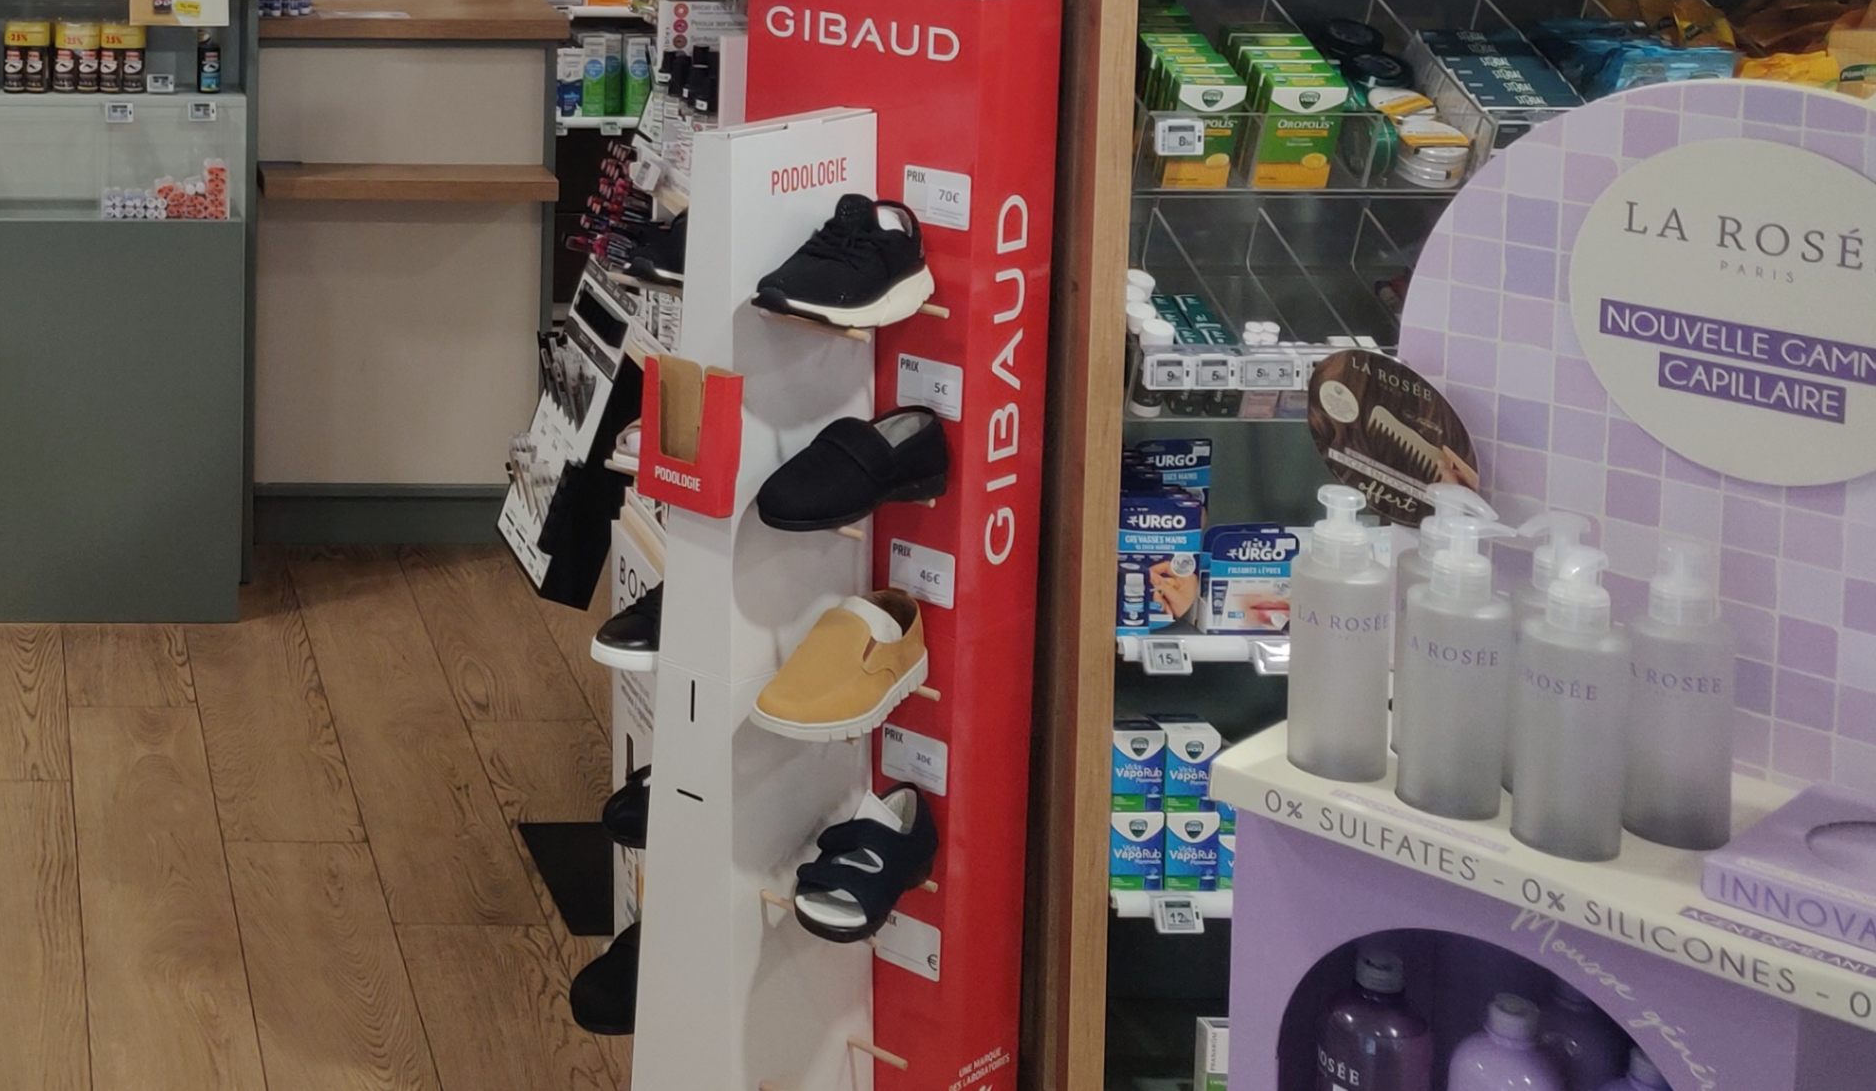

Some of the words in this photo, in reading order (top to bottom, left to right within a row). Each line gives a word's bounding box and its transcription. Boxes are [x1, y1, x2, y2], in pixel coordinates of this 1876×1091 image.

[766, 5, 960, 61] GIBAUD
[771, 157, 847, 196] PODOLOGIE
[906, 169, 925, 184] PRIX
[1624, 201, 1689, 242] LA
[1720, 260, 1795, 284] PARIS
[1606, 305, 1771, 360] NOUVELLE
[899, 356, 919, 374] PRIX
[933, 381, 948, 396] 5€
[984, 193, 1028, 565] GIBAUD
[1352, 357, 1371, 375] LA
[1378, 369, 1432, 401] ROSÉE
[1664, 360, 1840, 417] CAPILLAIRE
[1155, 454, 1197, 467] URGO
[654, 465, 702, 492] PODOLOGIE
[1139, 515, 1186, 529] URGO
[892, 542, 912, 558] PRIX
[1238, 547, 1286, 561] URGO
[1298, 607, 1320, 627] LA
[1428, 644, 1499, 668] ROSÉE
[1646, 667, 1723, 695] ROSÉE
[884, 727, 904, 743] PRIX
[1115, 766, 1163, 780] VapoRub
[1114, 848, 1162, 861] VapoRub
[1170, 848, 1217, 861] VapoRub
[1264, 789, 1304, 820] 0%
[1522, 877, 1566, 913] 0%
[1583, 900, 1796, 996] SILICONES
[1510, 909, 1637, 1001] Mousse
[958, 1062, 973, 1078] UNE
[973, 1046, 1003, 1073] MARQUE
[961, 1052, 1011, 1089] LABORATOIRES
[1318, 1045, 1360, 1087] OSÉE
